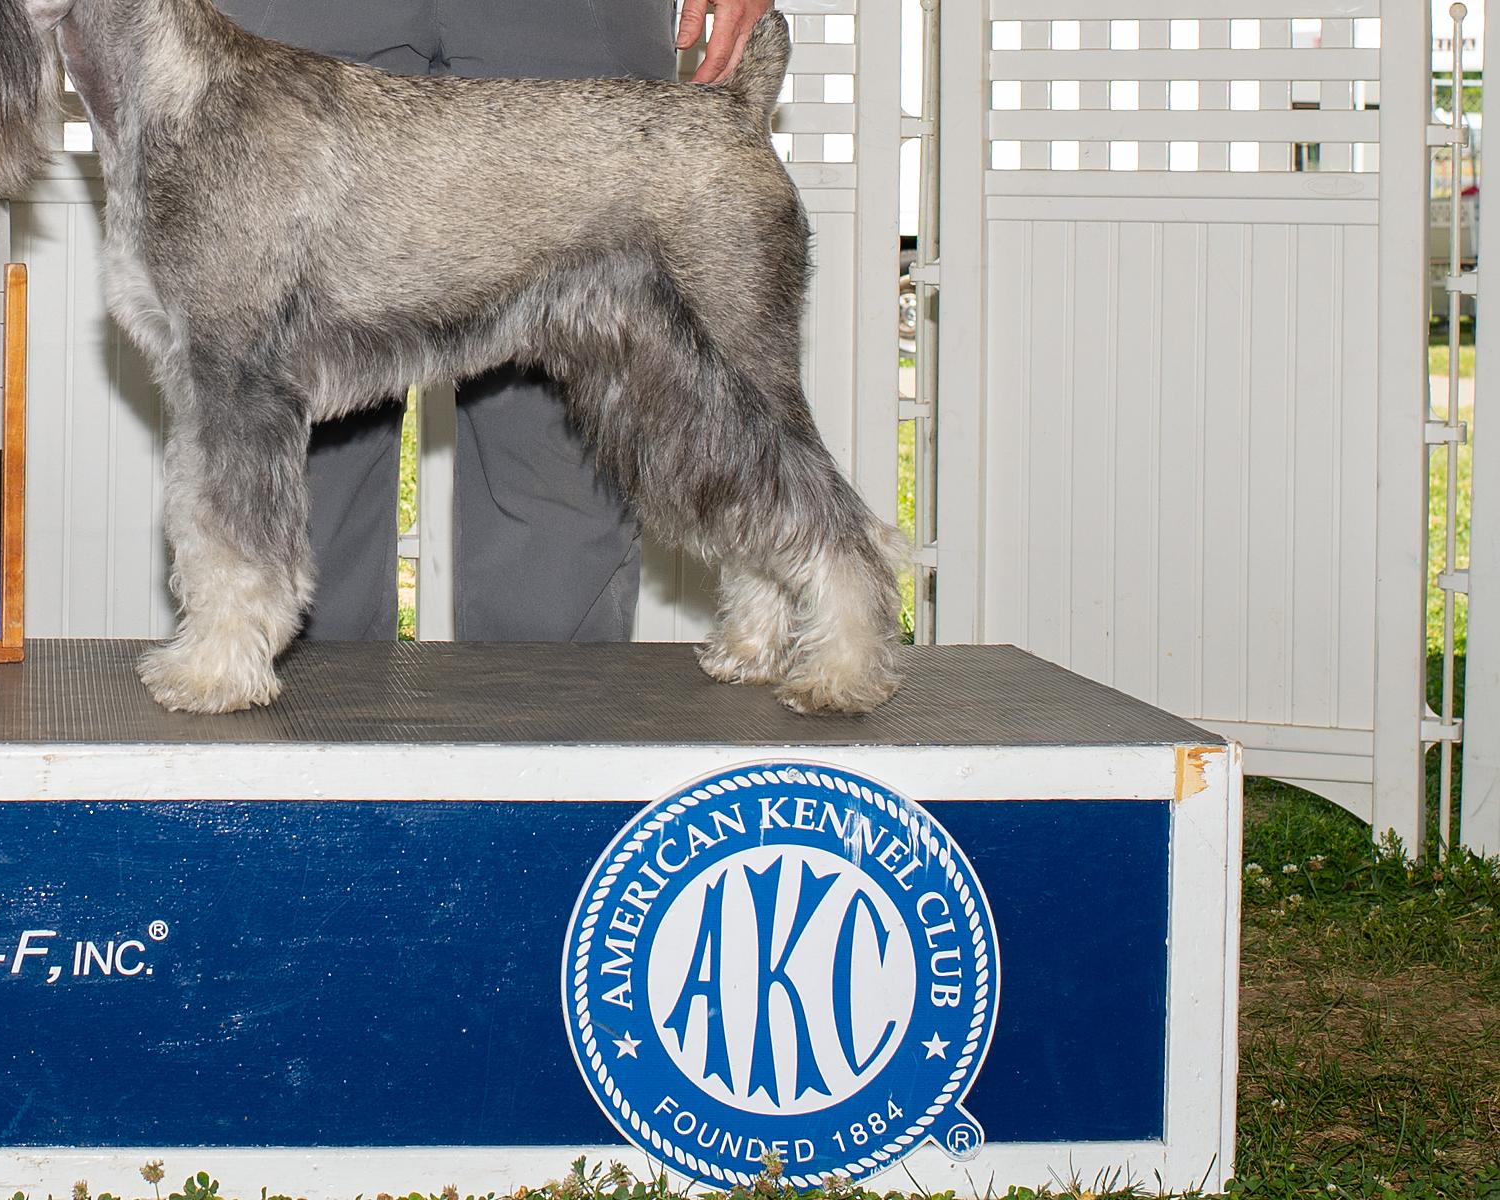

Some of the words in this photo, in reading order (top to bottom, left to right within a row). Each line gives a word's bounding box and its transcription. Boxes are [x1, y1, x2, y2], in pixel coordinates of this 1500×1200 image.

[601, 804, 746, 1011] AMERICAN
[758, 796, 924, 891] KENNEL
[915, 891, 962, 1008] CLUB
[663, 854, 896, 1108] AKC
[653, 1095, 815, 1164] FOUNDED
[832, 1098, 904, 1153] 1884
